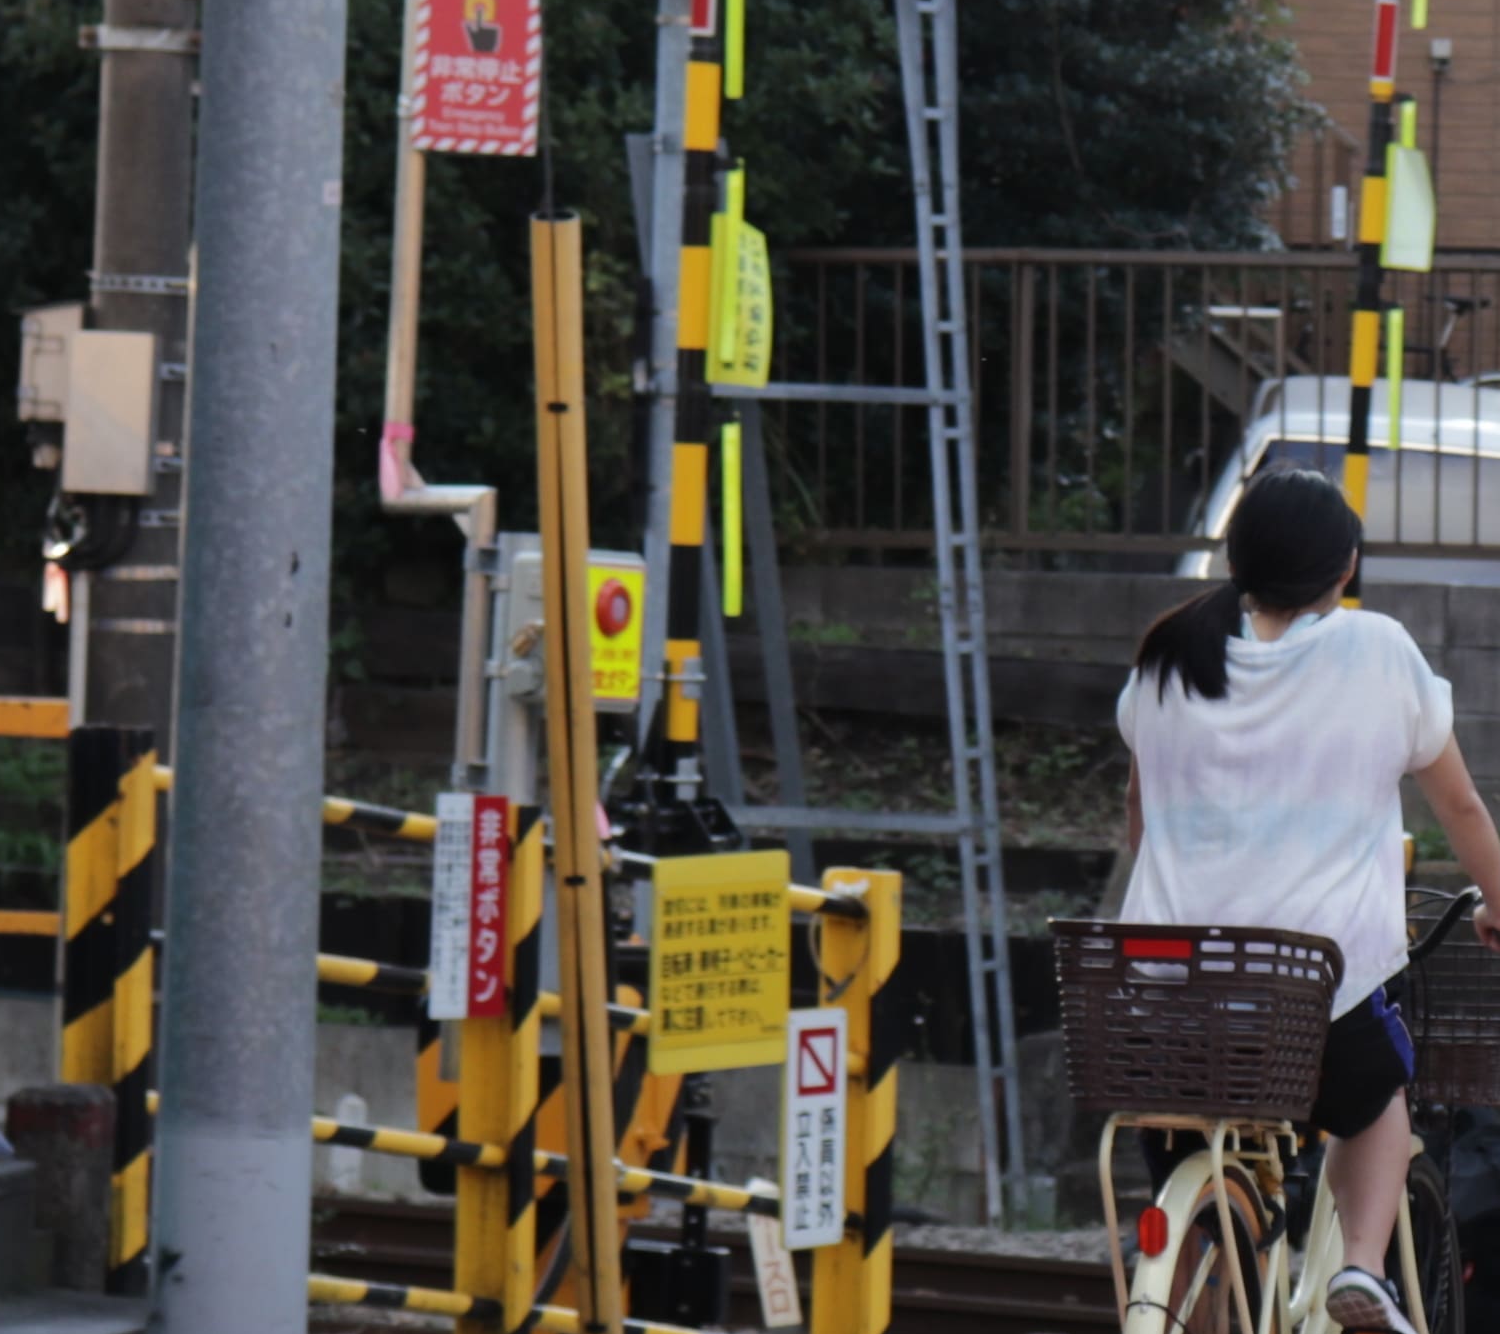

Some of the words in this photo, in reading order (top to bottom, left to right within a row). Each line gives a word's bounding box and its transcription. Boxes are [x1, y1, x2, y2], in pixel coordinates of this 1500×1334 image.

[441, 81, 510, 107] ボタン
[474, 808, 503, 1004] 非常ボタン
